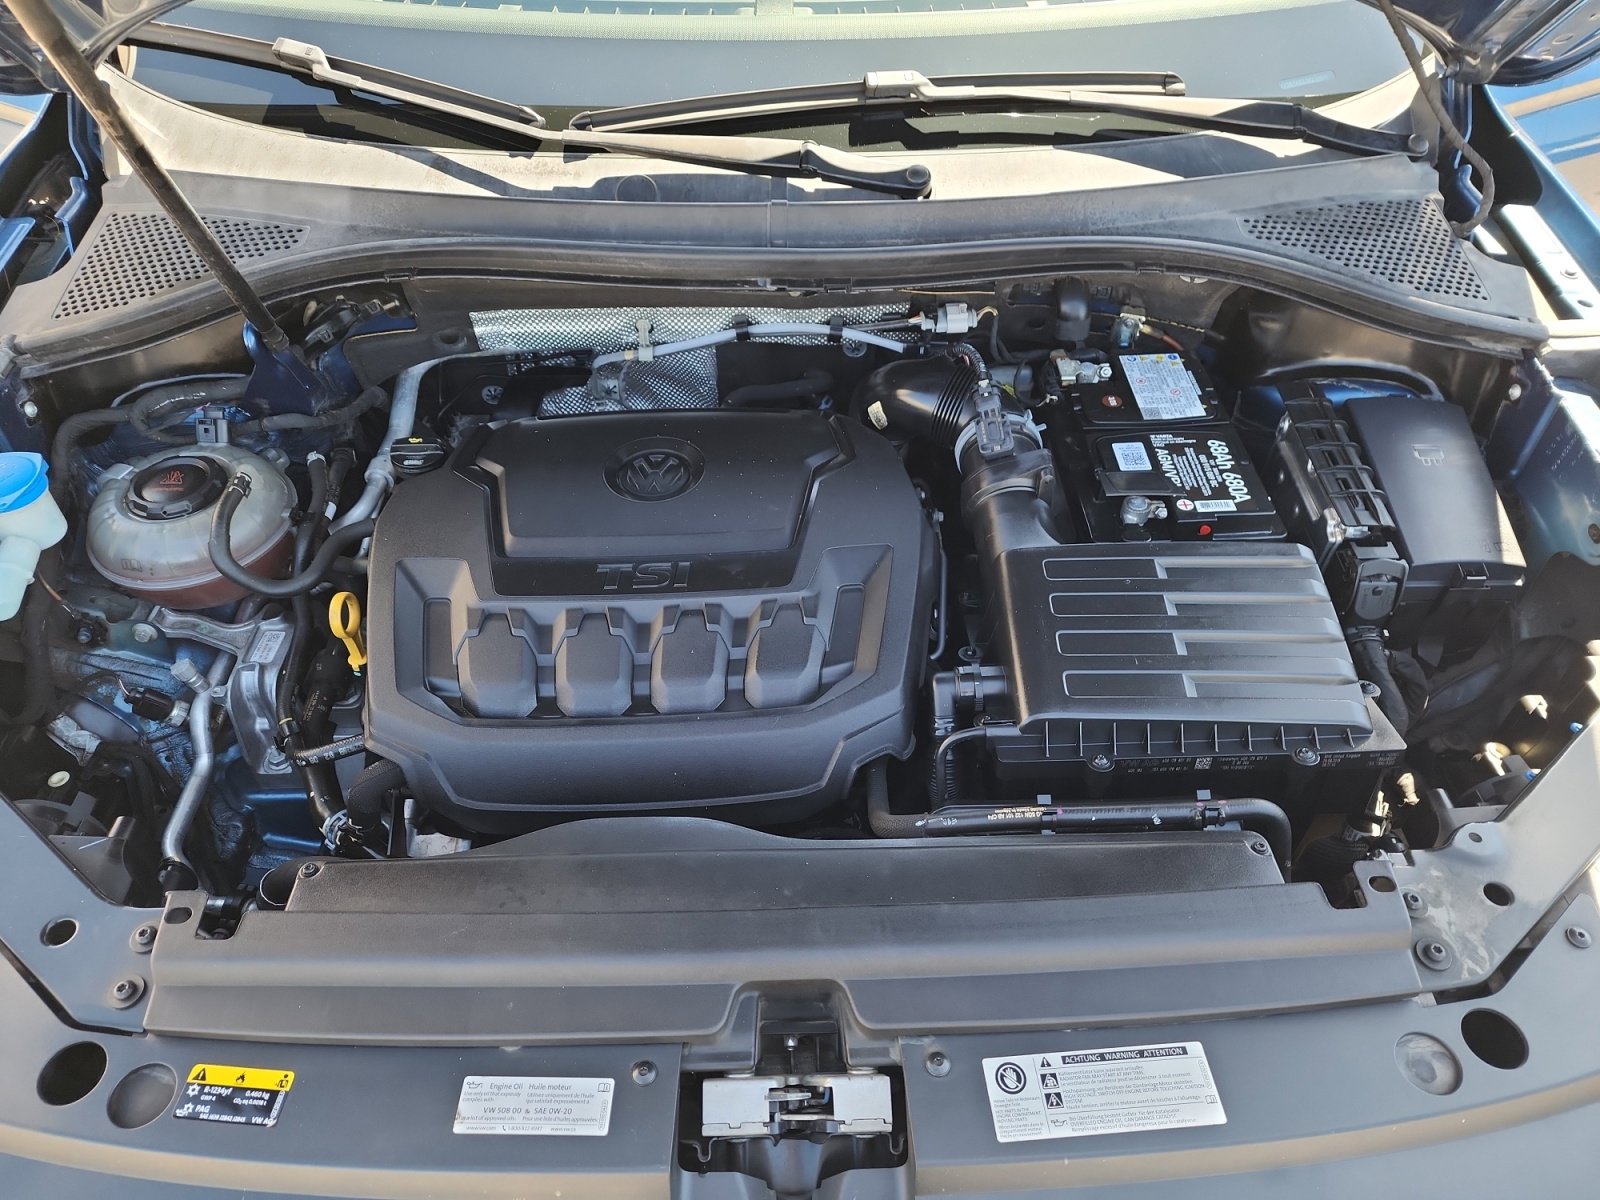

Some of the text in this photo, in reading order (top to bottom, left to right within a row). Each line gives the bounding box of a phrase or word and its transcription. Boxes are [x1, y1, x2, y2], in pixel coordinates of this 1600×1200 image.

[1207, 439, 1235, 469] 68Ah
[1222, 472, 1252, 503] 680A
[596, 561, 692, 590] TSI
[1065, 1047, 1183, 1063] ACHTUNG WARNING ATTENTION
[204, 1086, 233, 1097] R-1234yf
[262, 1092, 270, 1100] kg
[490, 1083, 512, 1091] Engine
[195, 1105, 211, 1113] PAG
